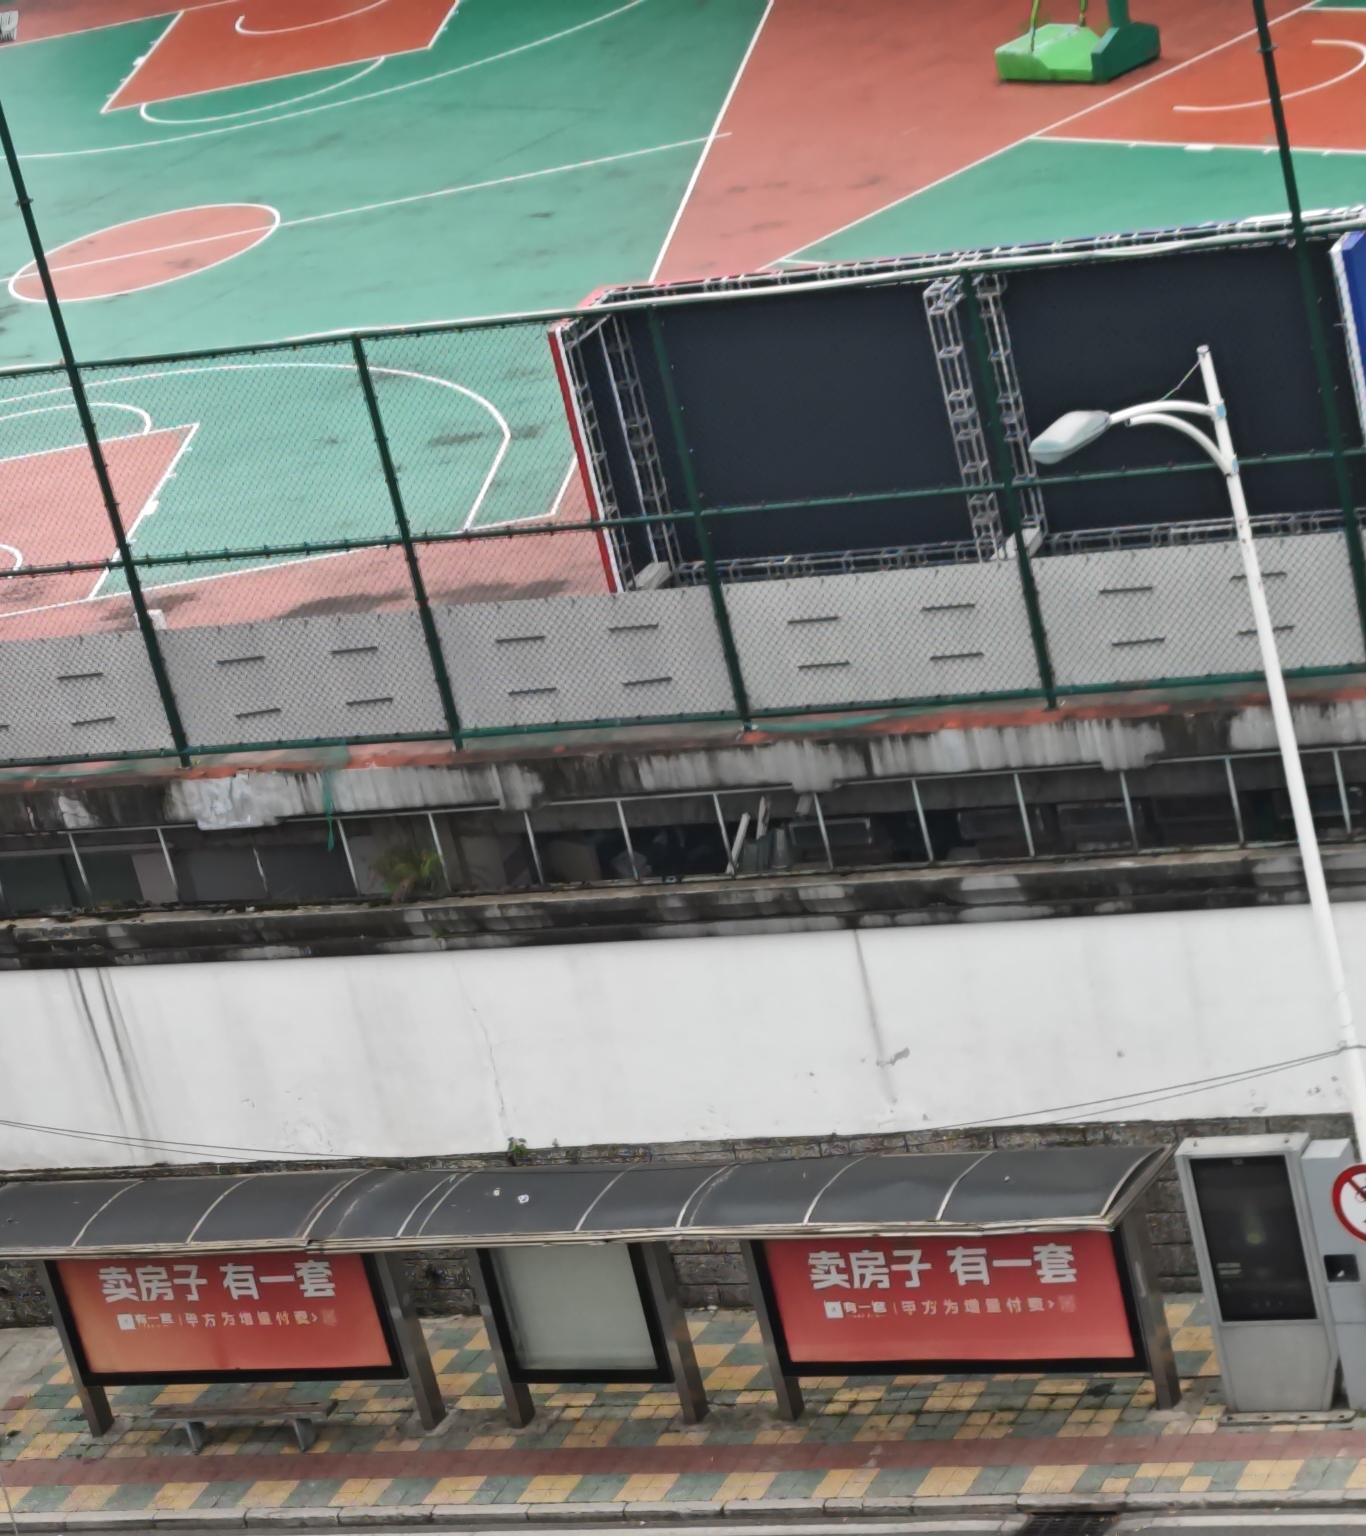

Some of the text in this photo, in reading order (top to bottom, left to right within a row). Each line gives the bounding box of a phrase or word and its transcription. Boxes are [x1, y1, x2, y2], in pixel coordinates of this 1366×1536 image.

[97, 1259, 336, 1304] 卖房子 有一套
[808, 1243, 1078, 1290] 卖房子 有一套
